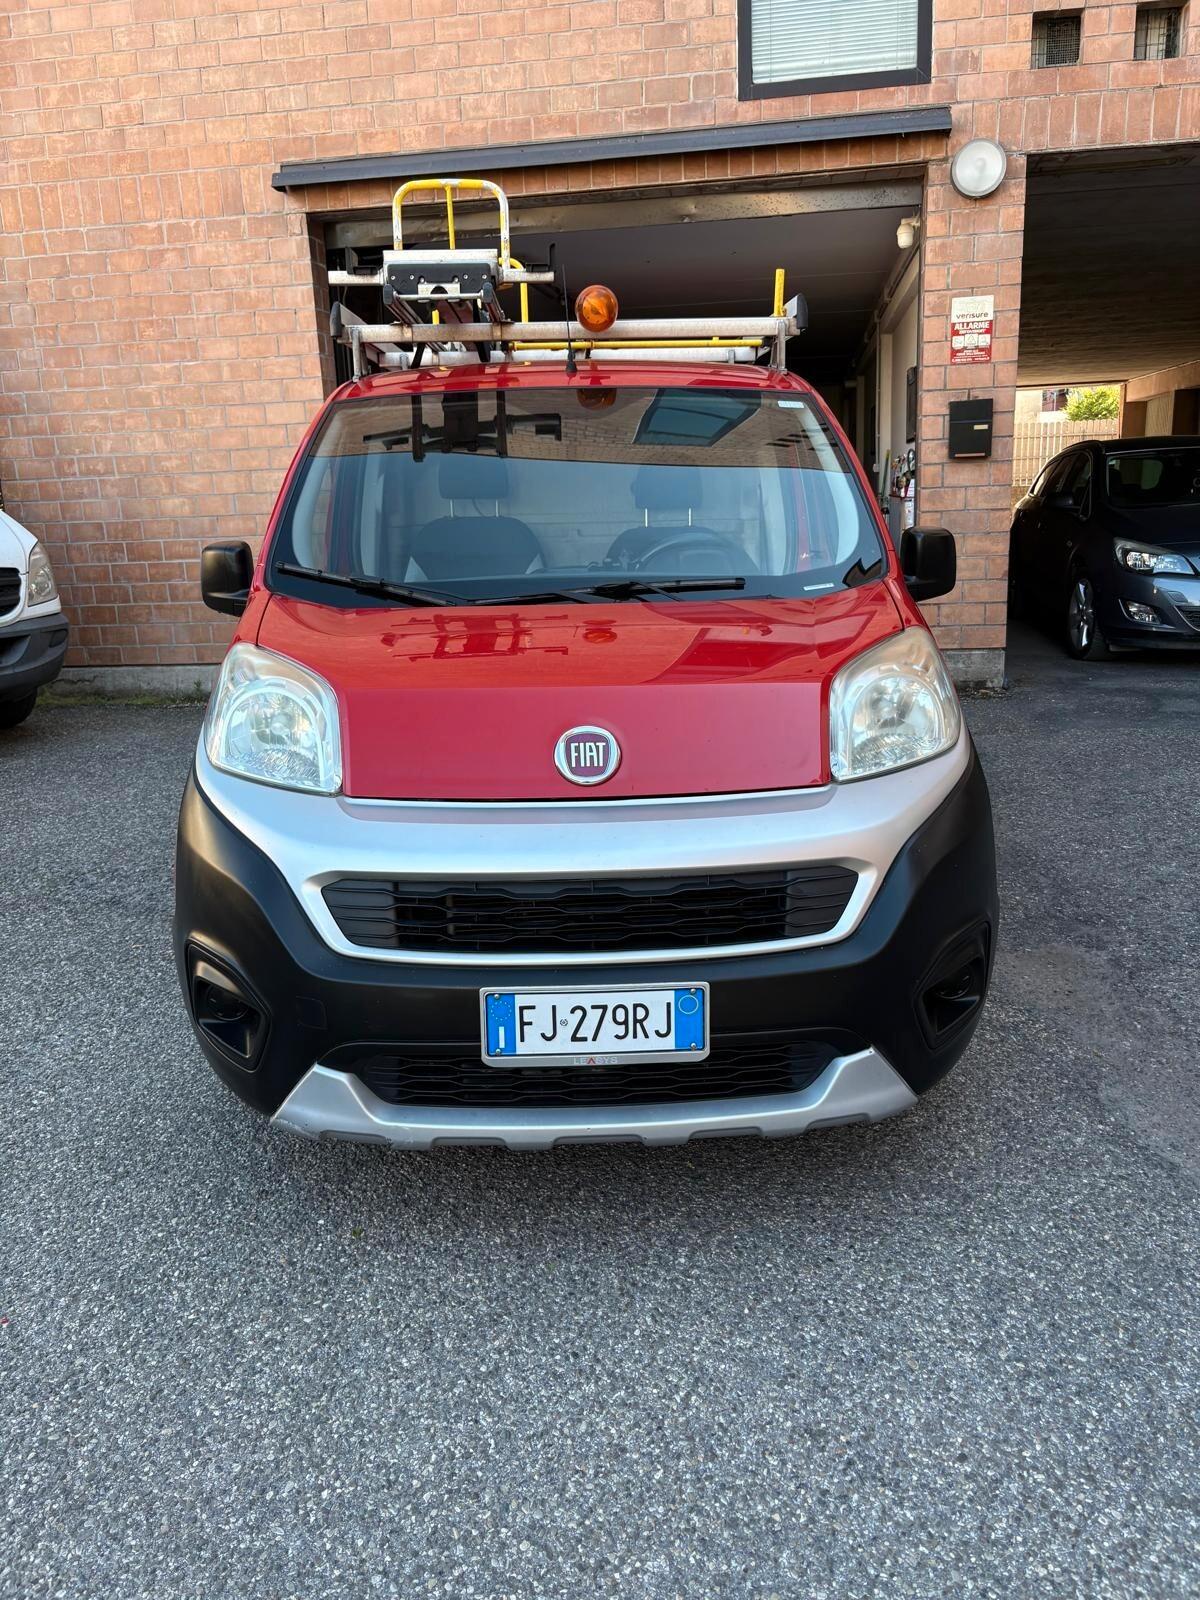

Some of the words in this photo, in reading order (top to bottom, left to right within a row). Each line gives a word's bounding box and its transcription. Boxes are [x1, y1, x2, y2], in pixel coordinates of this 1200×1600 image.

[954, 321, 990, 330] ALLARME
[570, 742, 606, 767] FIAT
[573, 1056, 618, 1065] LEASYS
